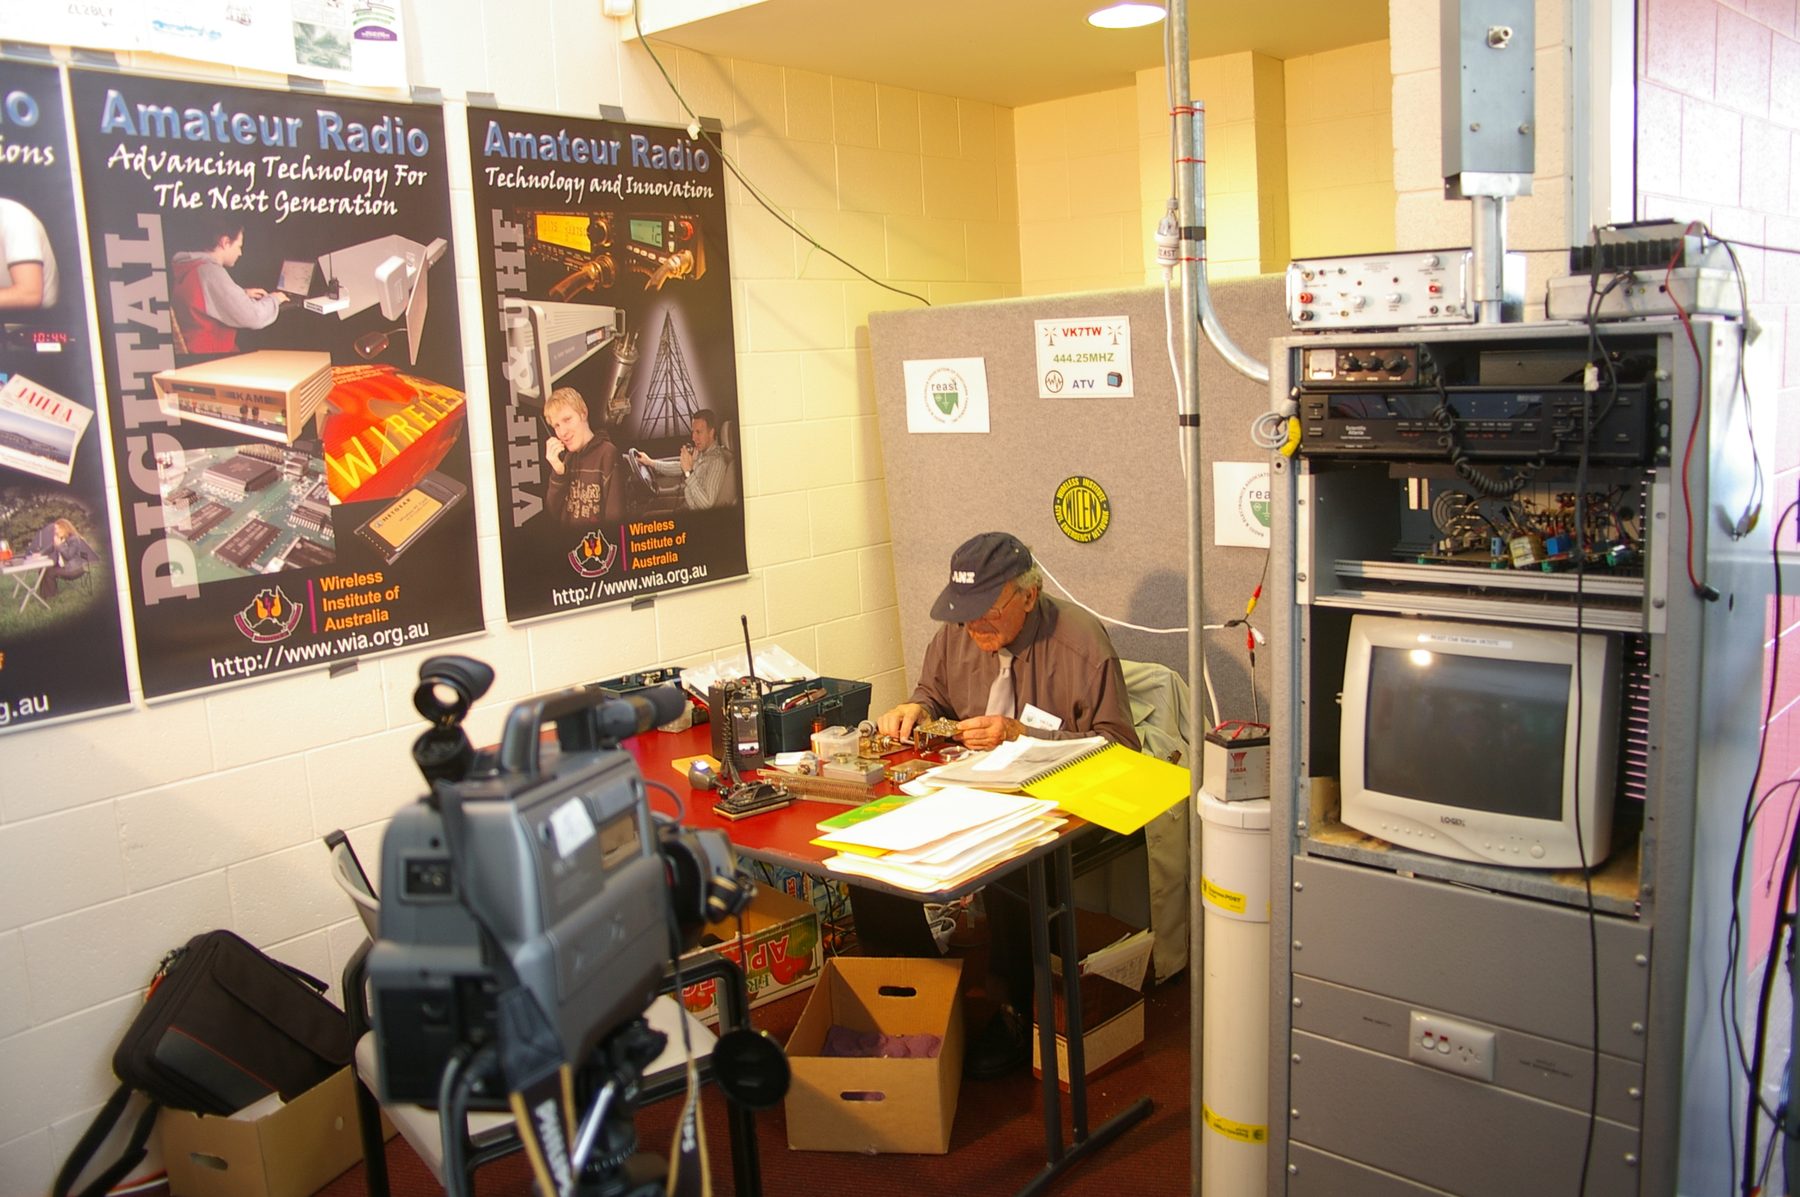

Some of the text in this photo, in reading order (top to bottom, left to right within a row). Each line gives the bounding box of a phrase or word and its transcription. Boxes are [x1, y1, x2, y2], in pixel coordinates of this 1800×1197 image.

[101, 89, 430, 158] Amateur Radio
[484, 120, 710, 173] Amateur Radio
[107, 143, 427, 197] Advancing Technology For
[485, 166, 714, 203] Technology and Innovation
[153, 183, 398, 223] The Next Generation
[492, 209, 529, 331] UHF
[1062, 327, 1102, 337] VK7TW
[1053, 353, 1114, 363] 444.25MHZ
[931, 379, 958, 391] reast
[1072, 380, 1095, 389] ATV
[104, 213, 200, 606] DIGITAL
[506, 404, 544, 527] VHF
[629, 520, 675, 536] Wireless
[1064, 489, 1098, 530] WICEN
[630, 532, 687, 553] Institute of
[632, 552, 679, 570] Australia
[320, 571, 384, 592] Wireless
[322, 586, 401, 612] Institute of
[552, 564, 708, 606] http://www.wia.org.au
[324, 609, 390, 632] Australia
[210, 622, 430, 679] http://www.wia.org.au
